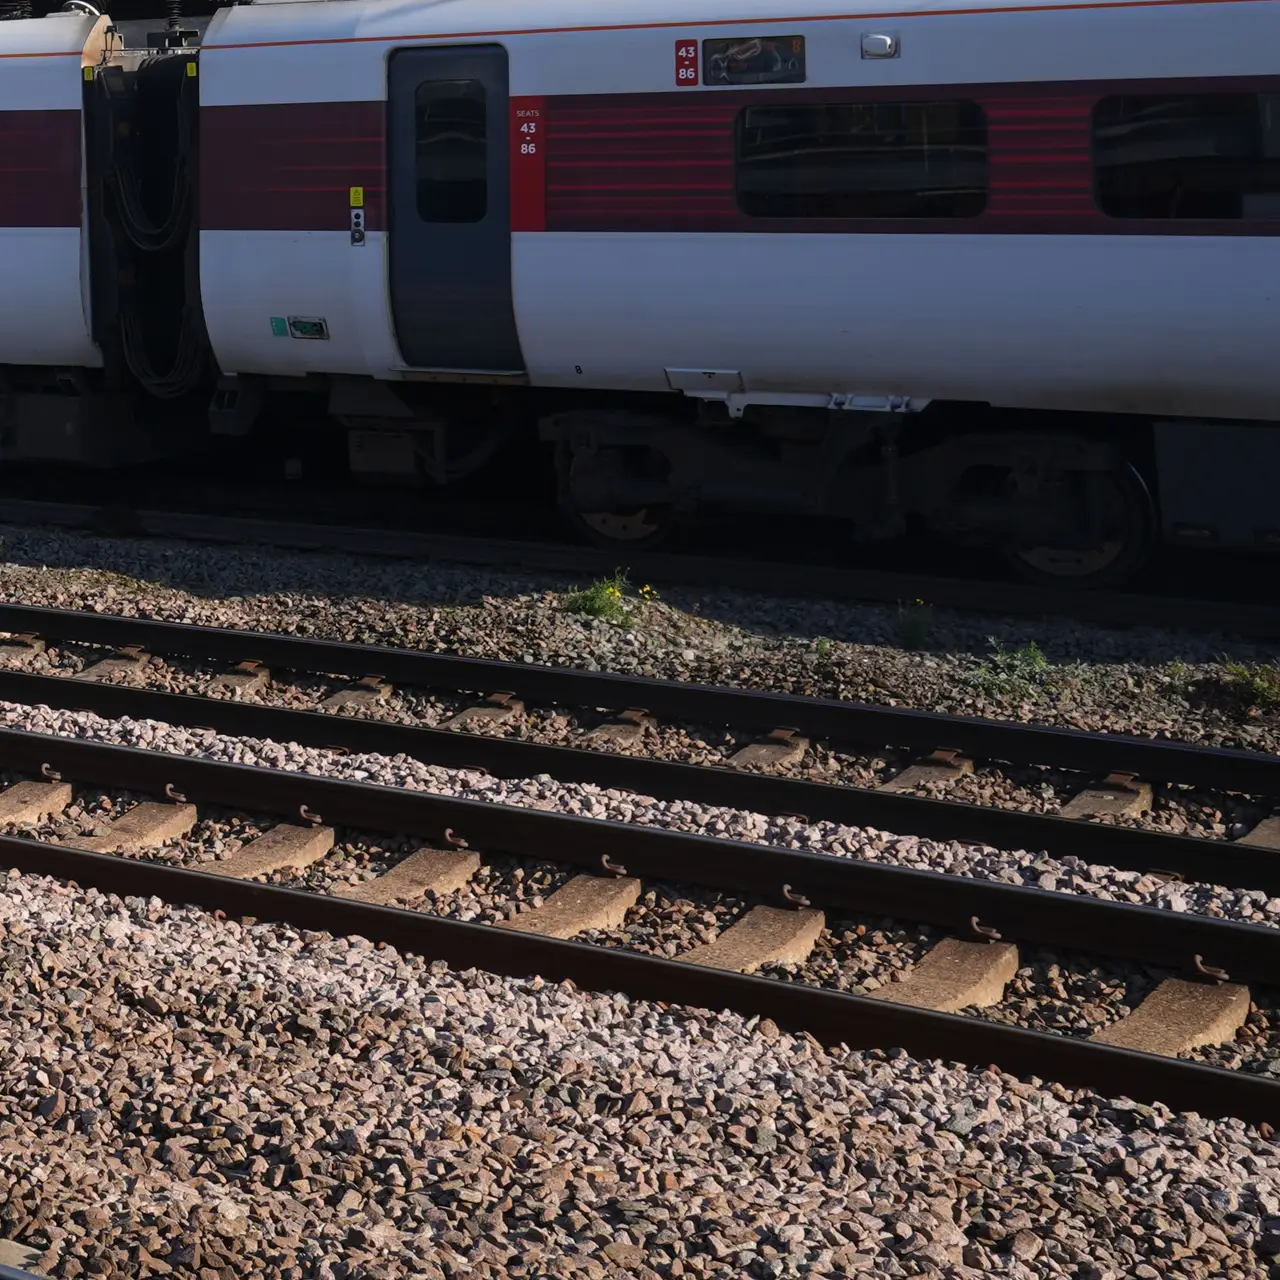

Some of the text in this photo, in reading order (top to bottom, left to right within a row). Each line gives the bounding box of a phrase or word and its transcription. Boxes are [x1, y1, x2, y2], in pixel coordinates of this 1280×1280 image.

[678, 47, 695, 58] 43
[679, 68, 696, 79] 86
[520, 123, 536, 133] 43
[521, 143, 536, 154] 86
